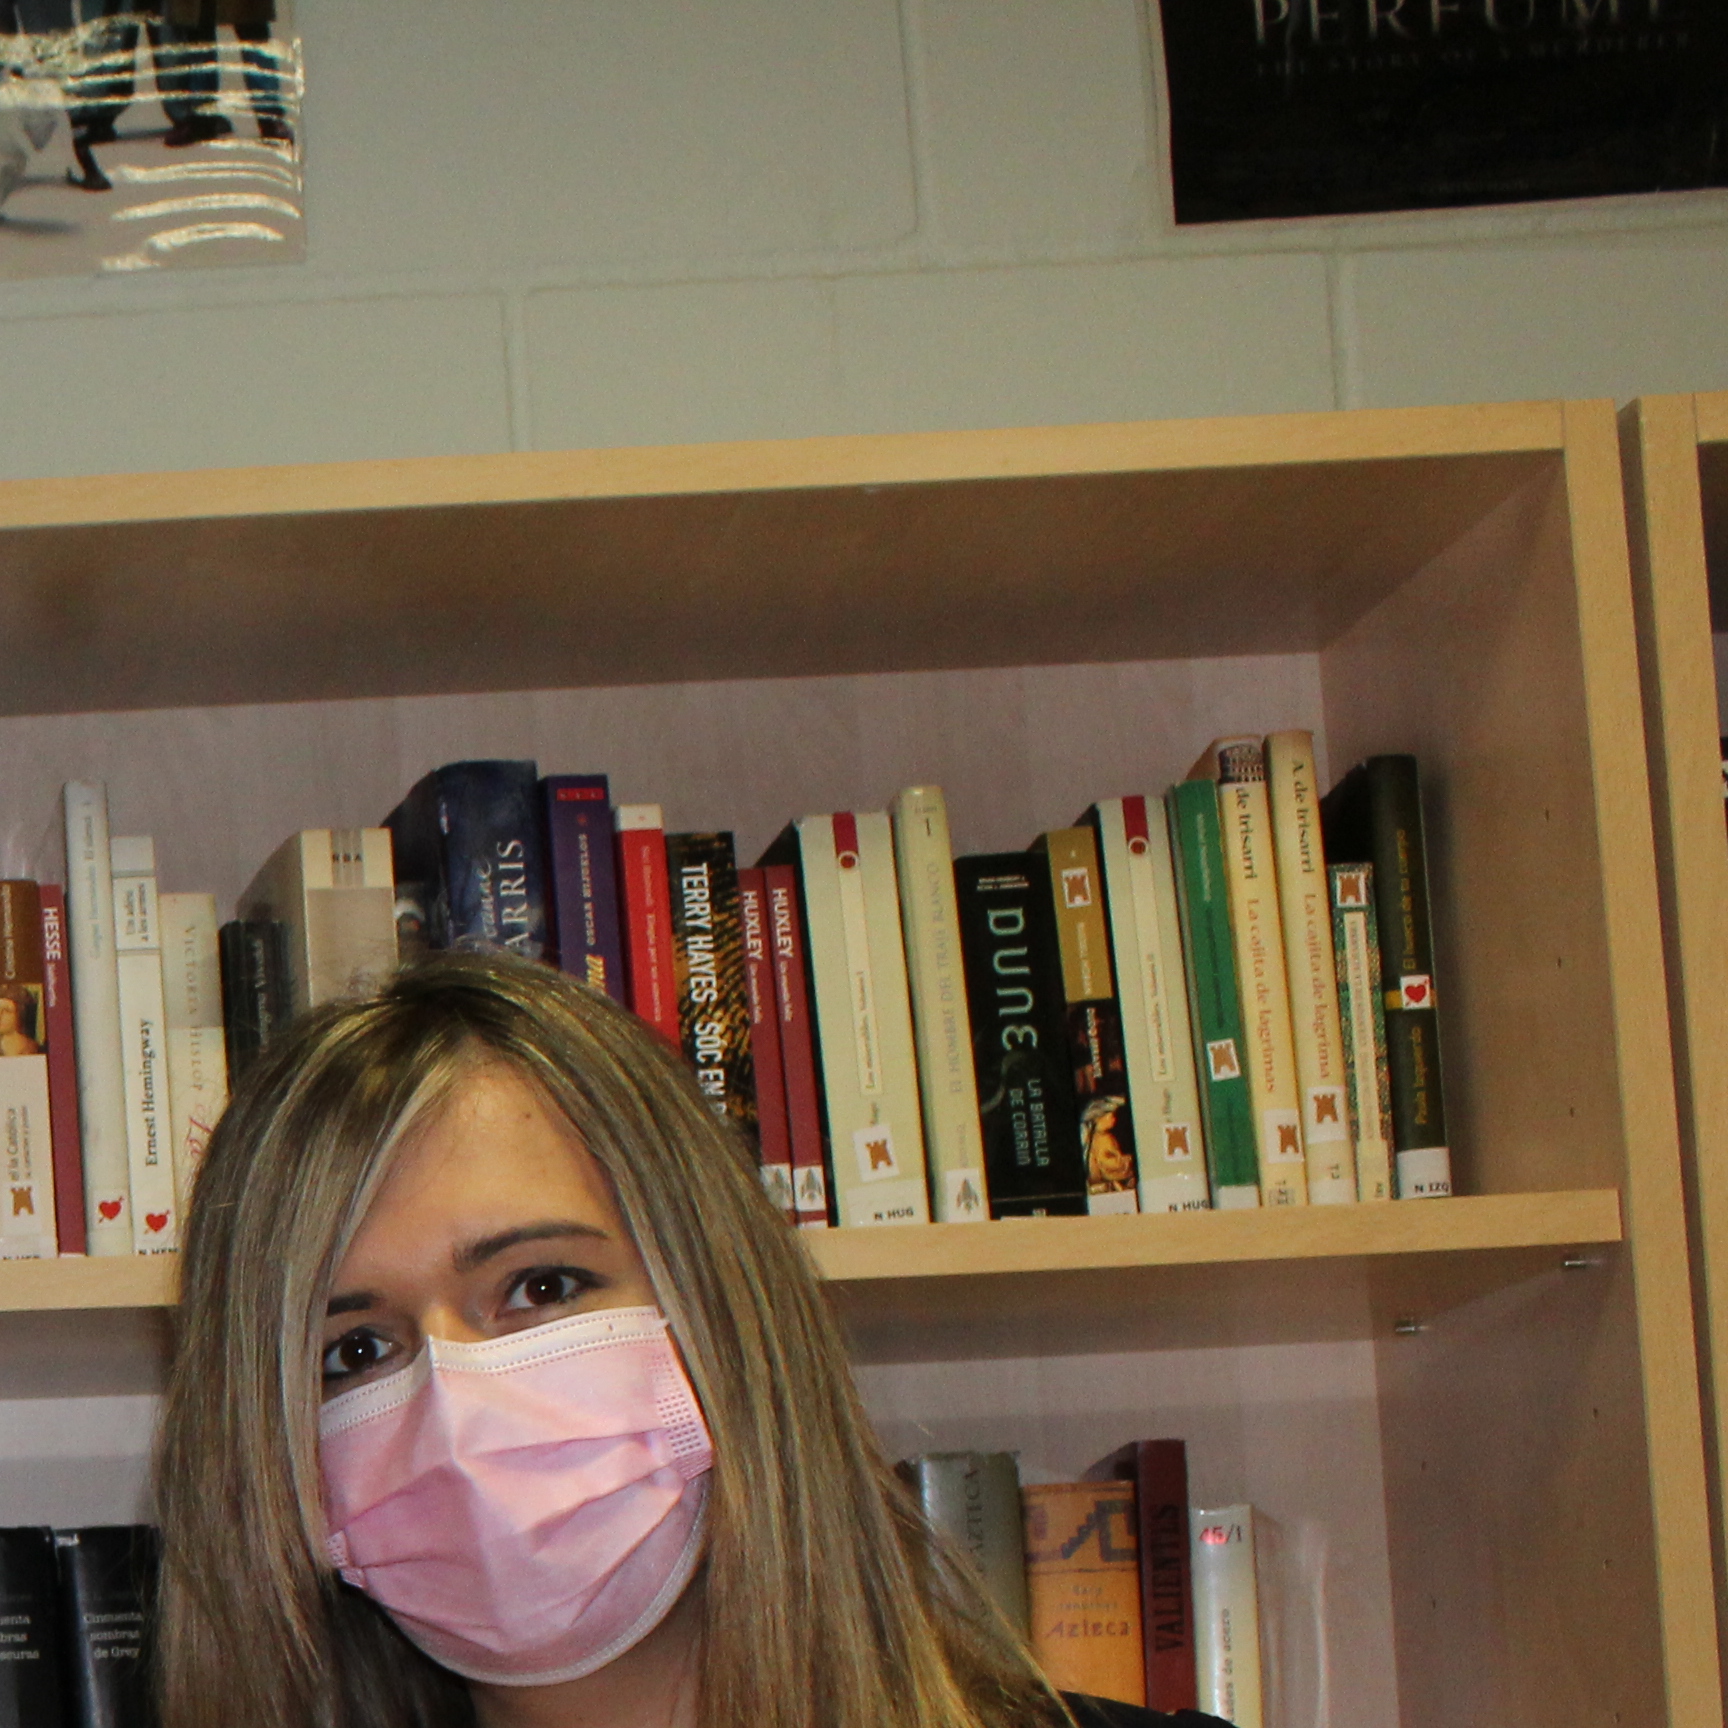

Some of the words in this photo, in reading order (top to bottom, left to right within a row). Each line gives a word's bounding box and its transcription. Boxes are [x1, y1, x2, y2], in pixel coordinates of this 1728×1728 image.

[681, 863, 709, 931] TERRY
[772, 887, 795, 960] HUXLEY
[1247, 898, 1261, 921] La
[44, 908, 62, 960] HESSE
[743, 891, 763, 960] HUXLEY
[1246, 925, 1266, 978] cajita
[687, 936, 717, 1007] HAYES
[1257, 983, 1271, 1004] de
[139, 1018, 157, 1112] Hemingway
[694, 1020, 729, 1066] SÓC
[1009, 1089, 1023, 1110] DE
[1028, 1077, 1041, 1099] LA
[144, 1113, 159, 1168] Ernest
[1030, 1105, 1050, 1166] BATALLA
[1153, 1504, 1183, 1651] VALIENTES
[1047, 1617, 1130, 1638] Azteca
